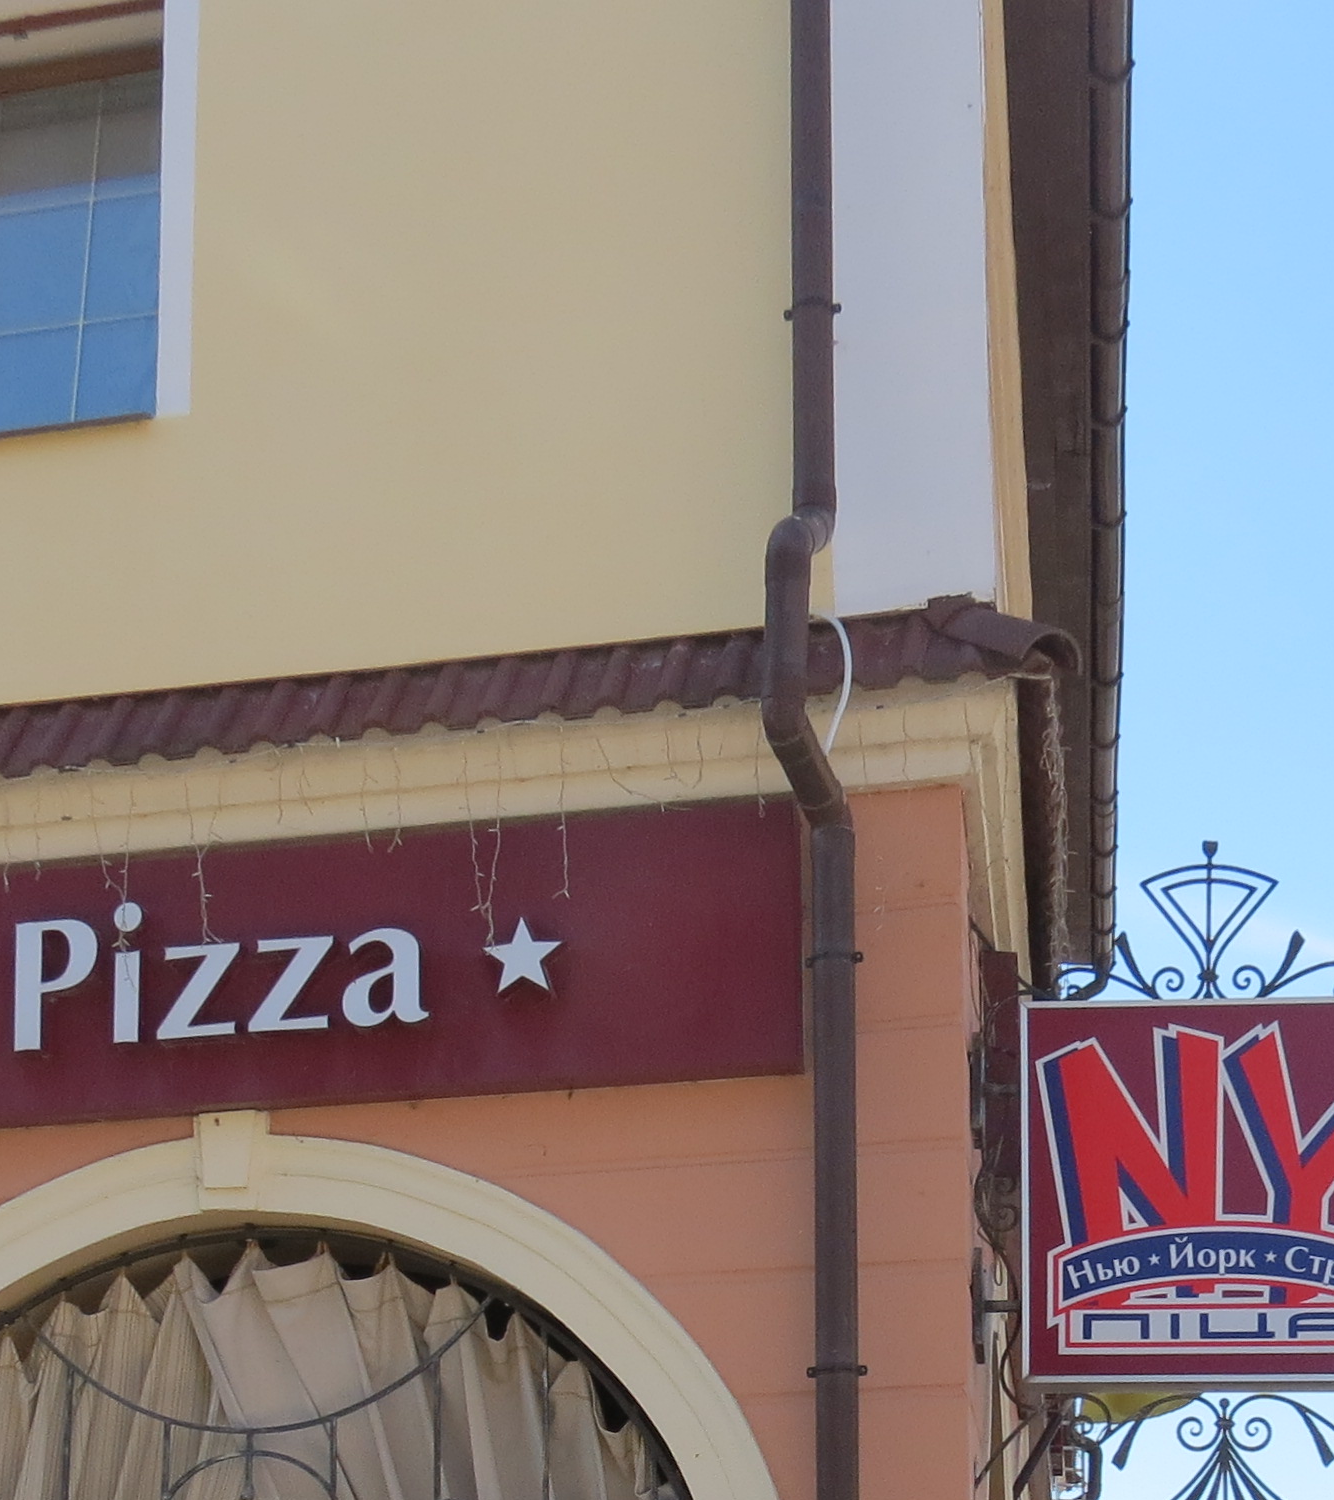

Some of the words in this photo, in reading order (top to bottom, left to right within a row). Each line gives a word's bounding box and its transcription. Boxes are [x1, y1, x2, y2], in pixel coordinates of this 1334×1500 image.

[12, 902, 431, 1053] Pizza
[1067, 1254, 1141, 1290] Нью
[1169, 1236, 1255, 1275] Йорк
